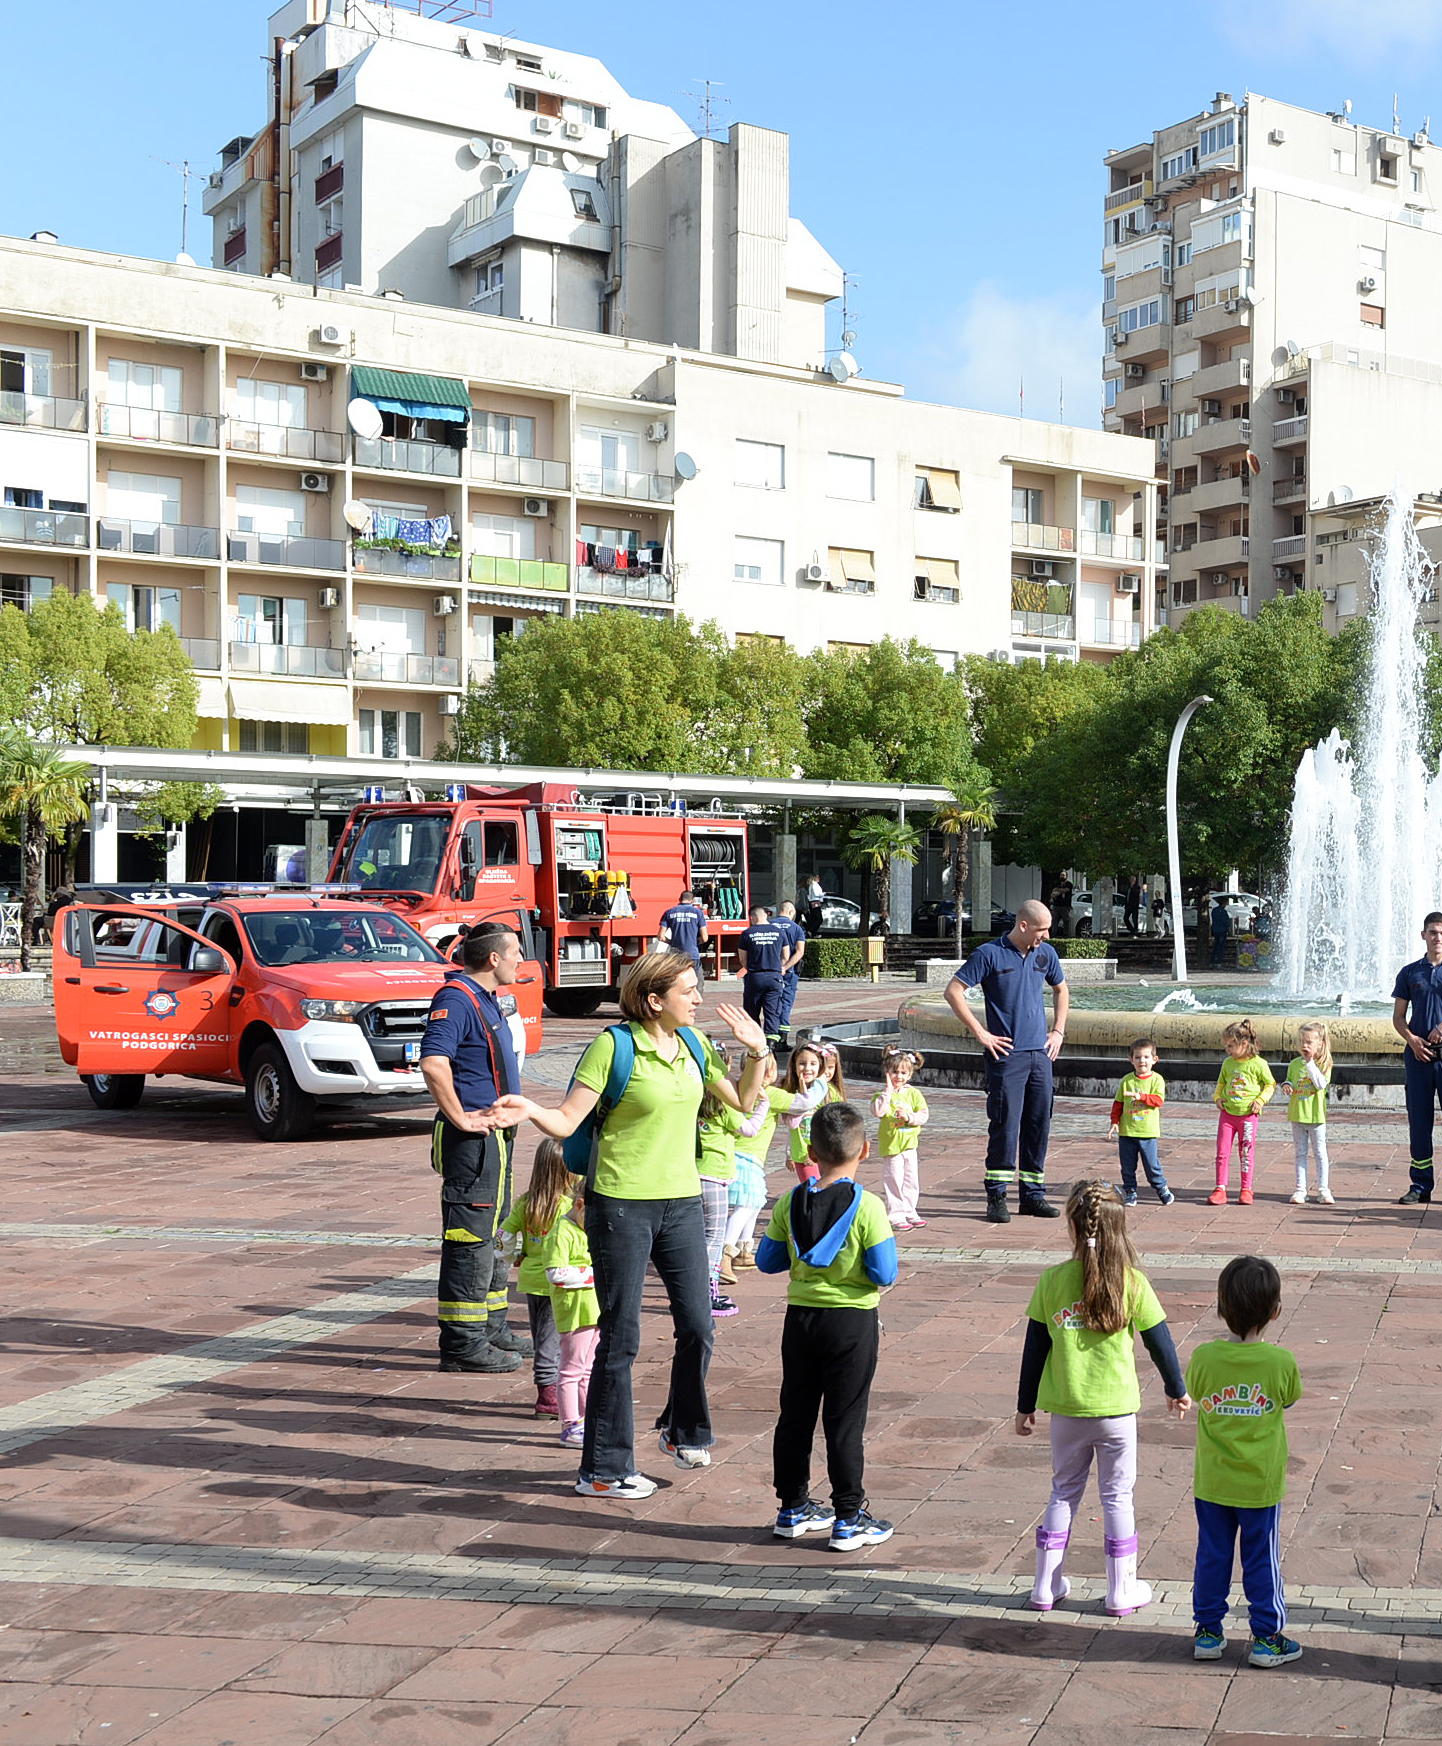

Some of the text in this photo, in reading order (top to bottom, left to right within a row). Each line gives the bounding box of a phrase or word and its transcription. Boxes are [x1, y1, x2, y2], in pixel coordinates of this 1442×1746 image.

[200, 990, 215, 1011] 3
[88, 1030, 229, 1042] VATROGASCI SPASIOCI
[121, 1041, 196, 1051] PODGORICA
